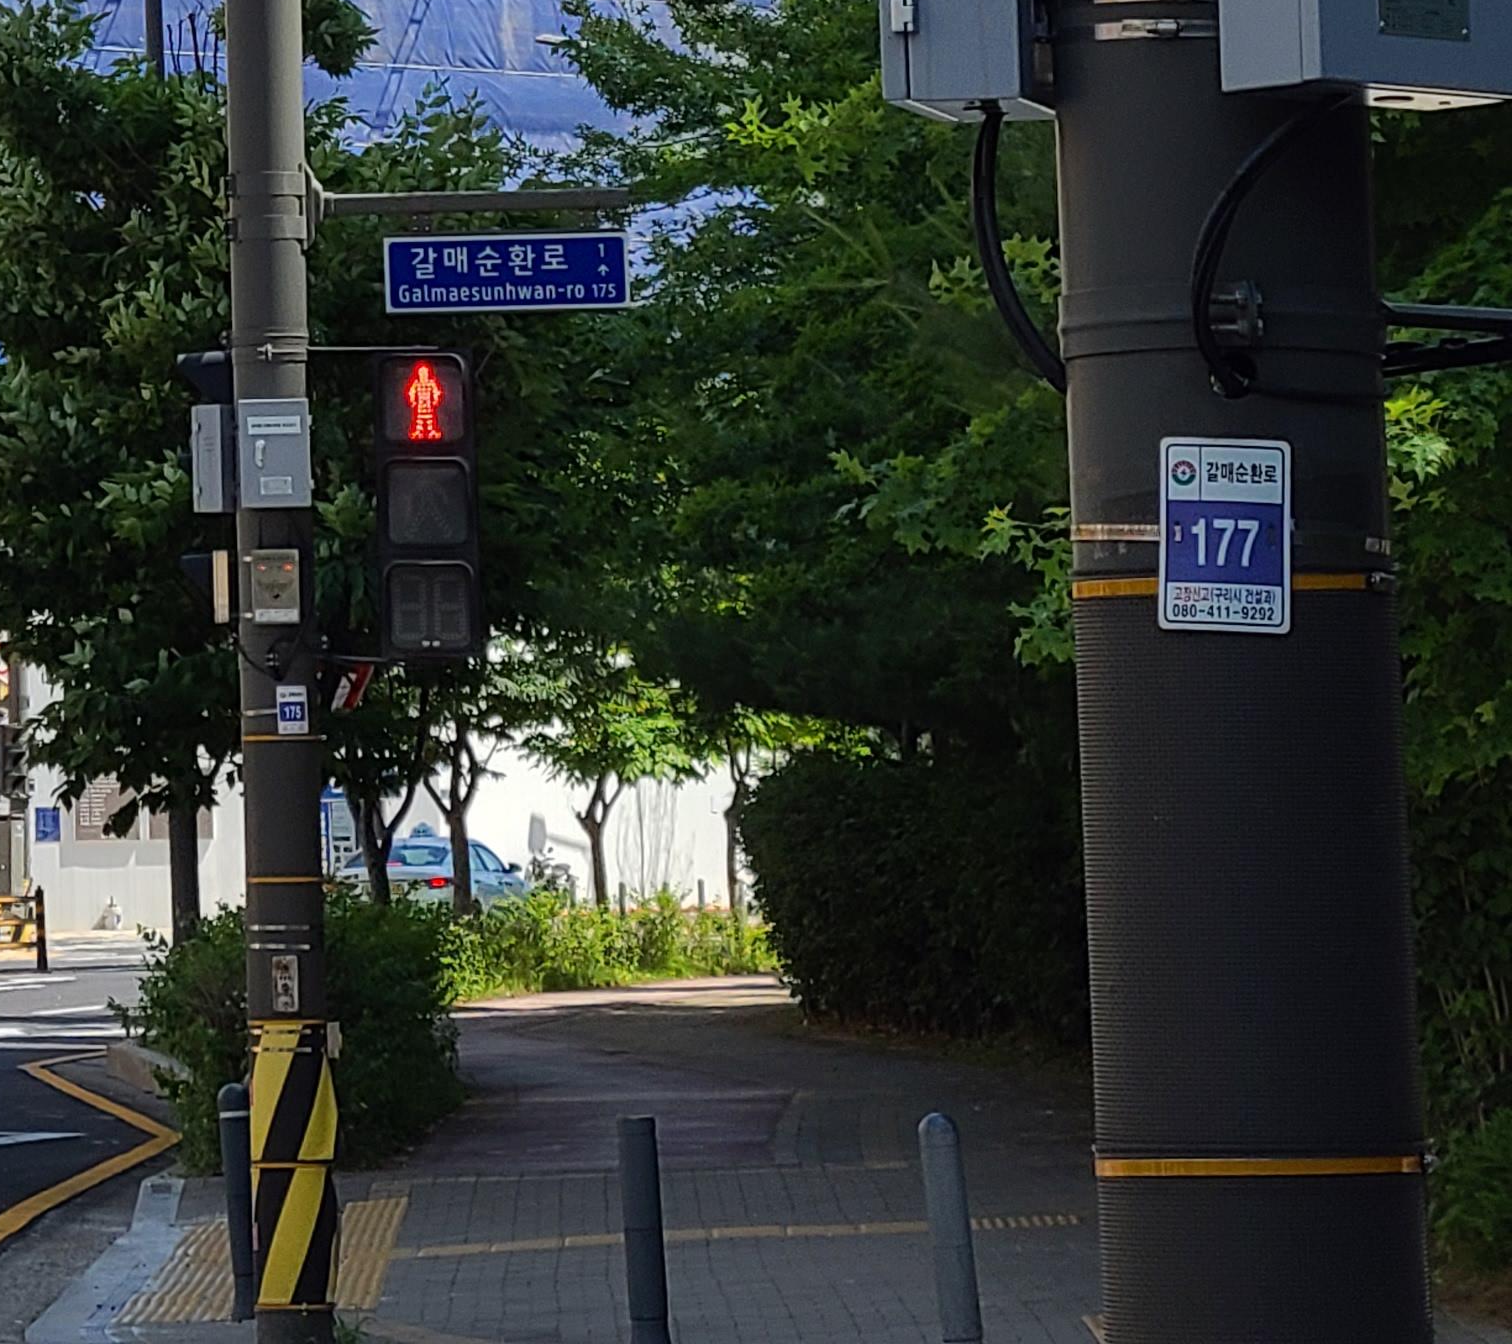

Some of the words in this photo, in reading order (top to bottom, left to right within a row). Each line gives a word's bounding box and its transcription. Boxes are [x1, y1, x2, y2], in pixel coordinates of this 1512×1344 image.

[410, 244, 569, 279] 갈매순환로
[597, 243, 605, 258] 1
[398, 281, 585, 303] Galmaesunhwan-ro
[591, 283, 617, 299] 175
[1206, 462, 1278, 484] 갈매순환로
[1191, 517, 1260, 568] 177
[1172, 604, 1275, 621] 080-411-9292
[283, 705, 302, 720] 175
